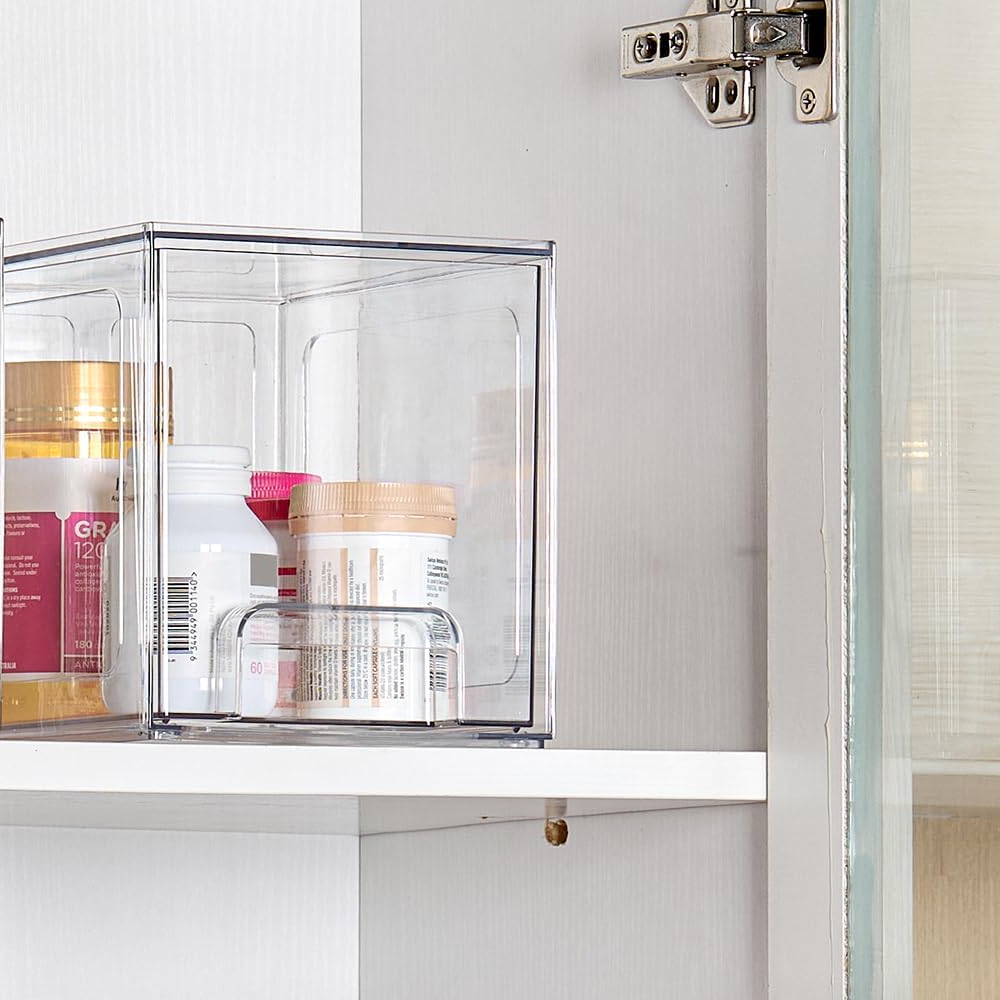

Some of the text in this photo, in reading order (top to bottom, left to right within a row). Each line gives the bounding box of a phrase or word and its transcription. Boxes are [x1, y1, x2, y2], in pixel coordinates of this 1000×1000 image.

[190, 579, 198, 614] 001140
[190, 617, 198, 651] 344949
[250, 662, 263, 674] 60
